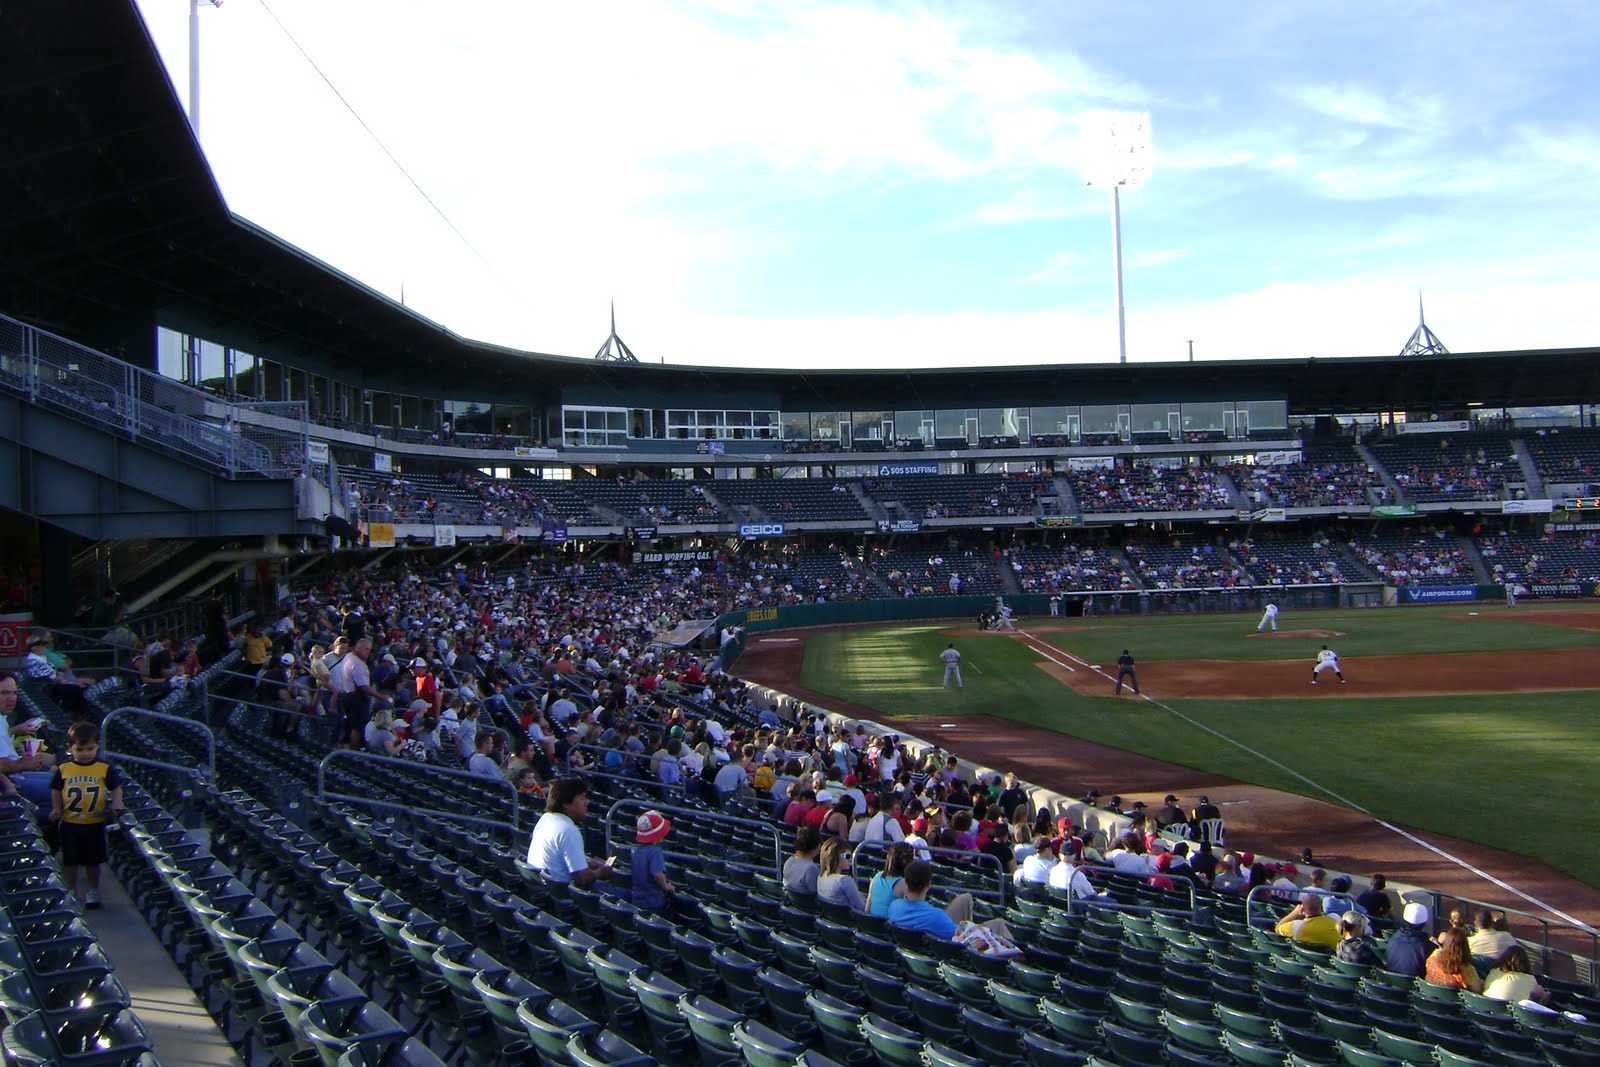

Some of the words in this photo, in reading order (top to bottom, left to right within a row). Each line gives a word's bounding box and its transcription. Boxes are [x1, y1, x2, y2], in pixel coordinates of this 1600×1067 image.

[891, 467, 904, 475] SOS
[905, 466, 937, 474] STAFFING
[1576, 499, 1582, 508] 2
[1594, 499, 1600, 507] 2
[741, 525, 783, 535] GEICO
[644, 553, 663, 562] HARD
[664, 552, 696, 562] WORKING
[697, 551, 712, 560] GAS.
[67, 785, 100, 813] 27
